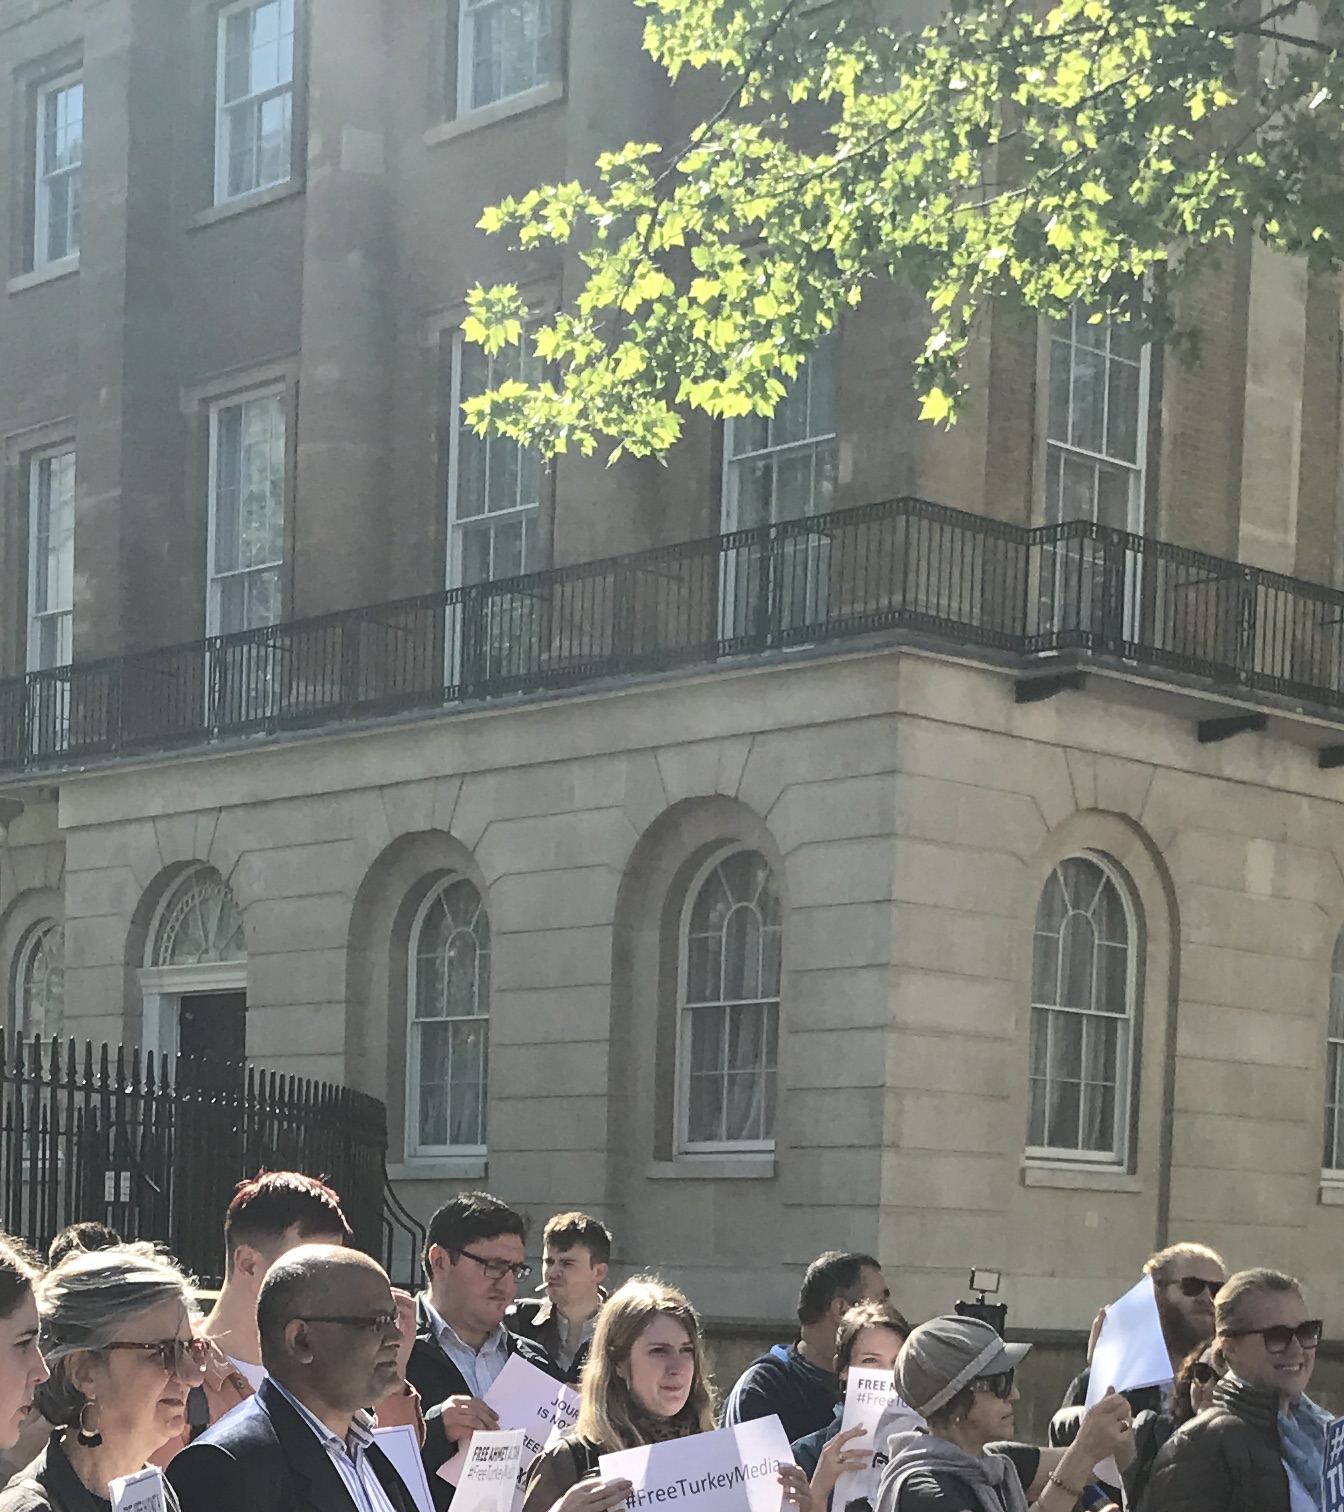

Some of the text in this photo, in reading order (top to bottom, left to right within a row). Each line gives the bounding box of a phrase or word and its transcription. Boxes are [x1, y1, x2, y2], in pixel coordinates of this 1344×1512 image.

[858, 1378, 887, 1391] FREE
[536, 1406, 550, 1419] IS
[625, 1457, 780, 1509] #FreeTurkeyMedia
